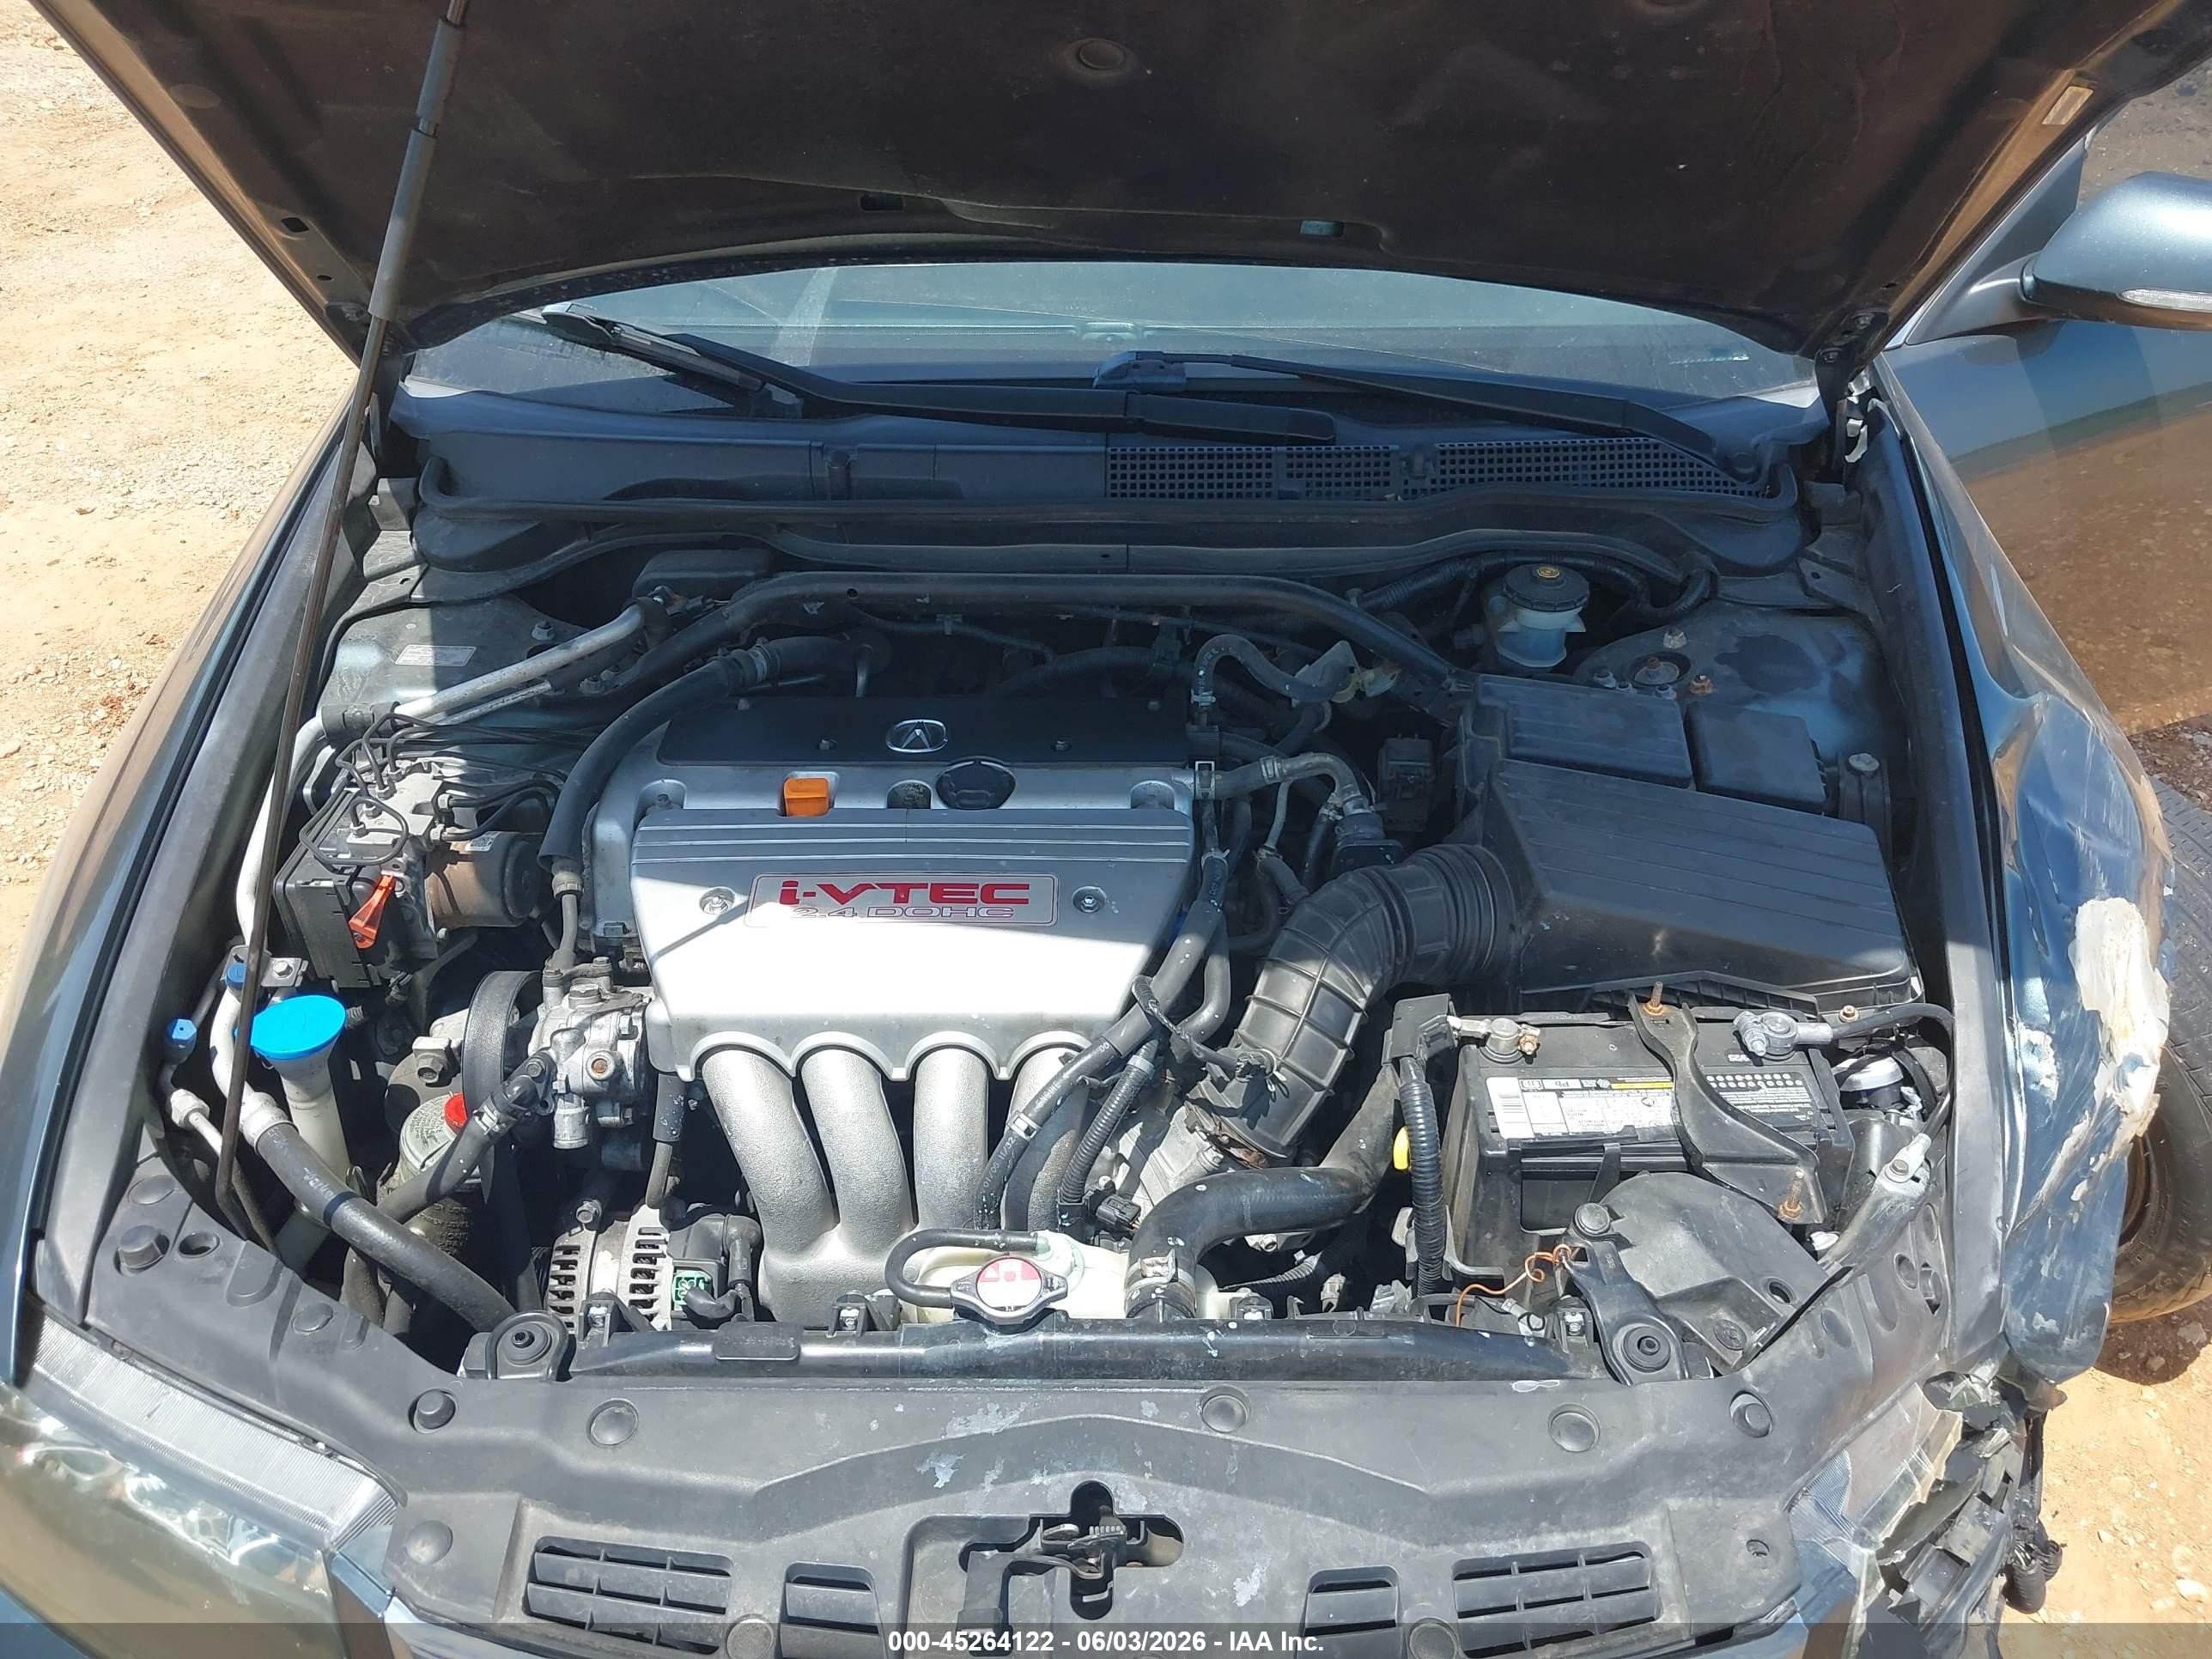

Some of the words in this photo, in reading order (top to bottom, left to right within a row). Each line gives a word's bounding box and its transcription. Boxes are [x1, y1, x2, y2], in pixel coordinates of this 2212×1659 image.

[779, 880, 1030, 905] i-VTEC
[792, 906, 858, 921] 2.4
[867, 906, 1014, 921] DOHC
